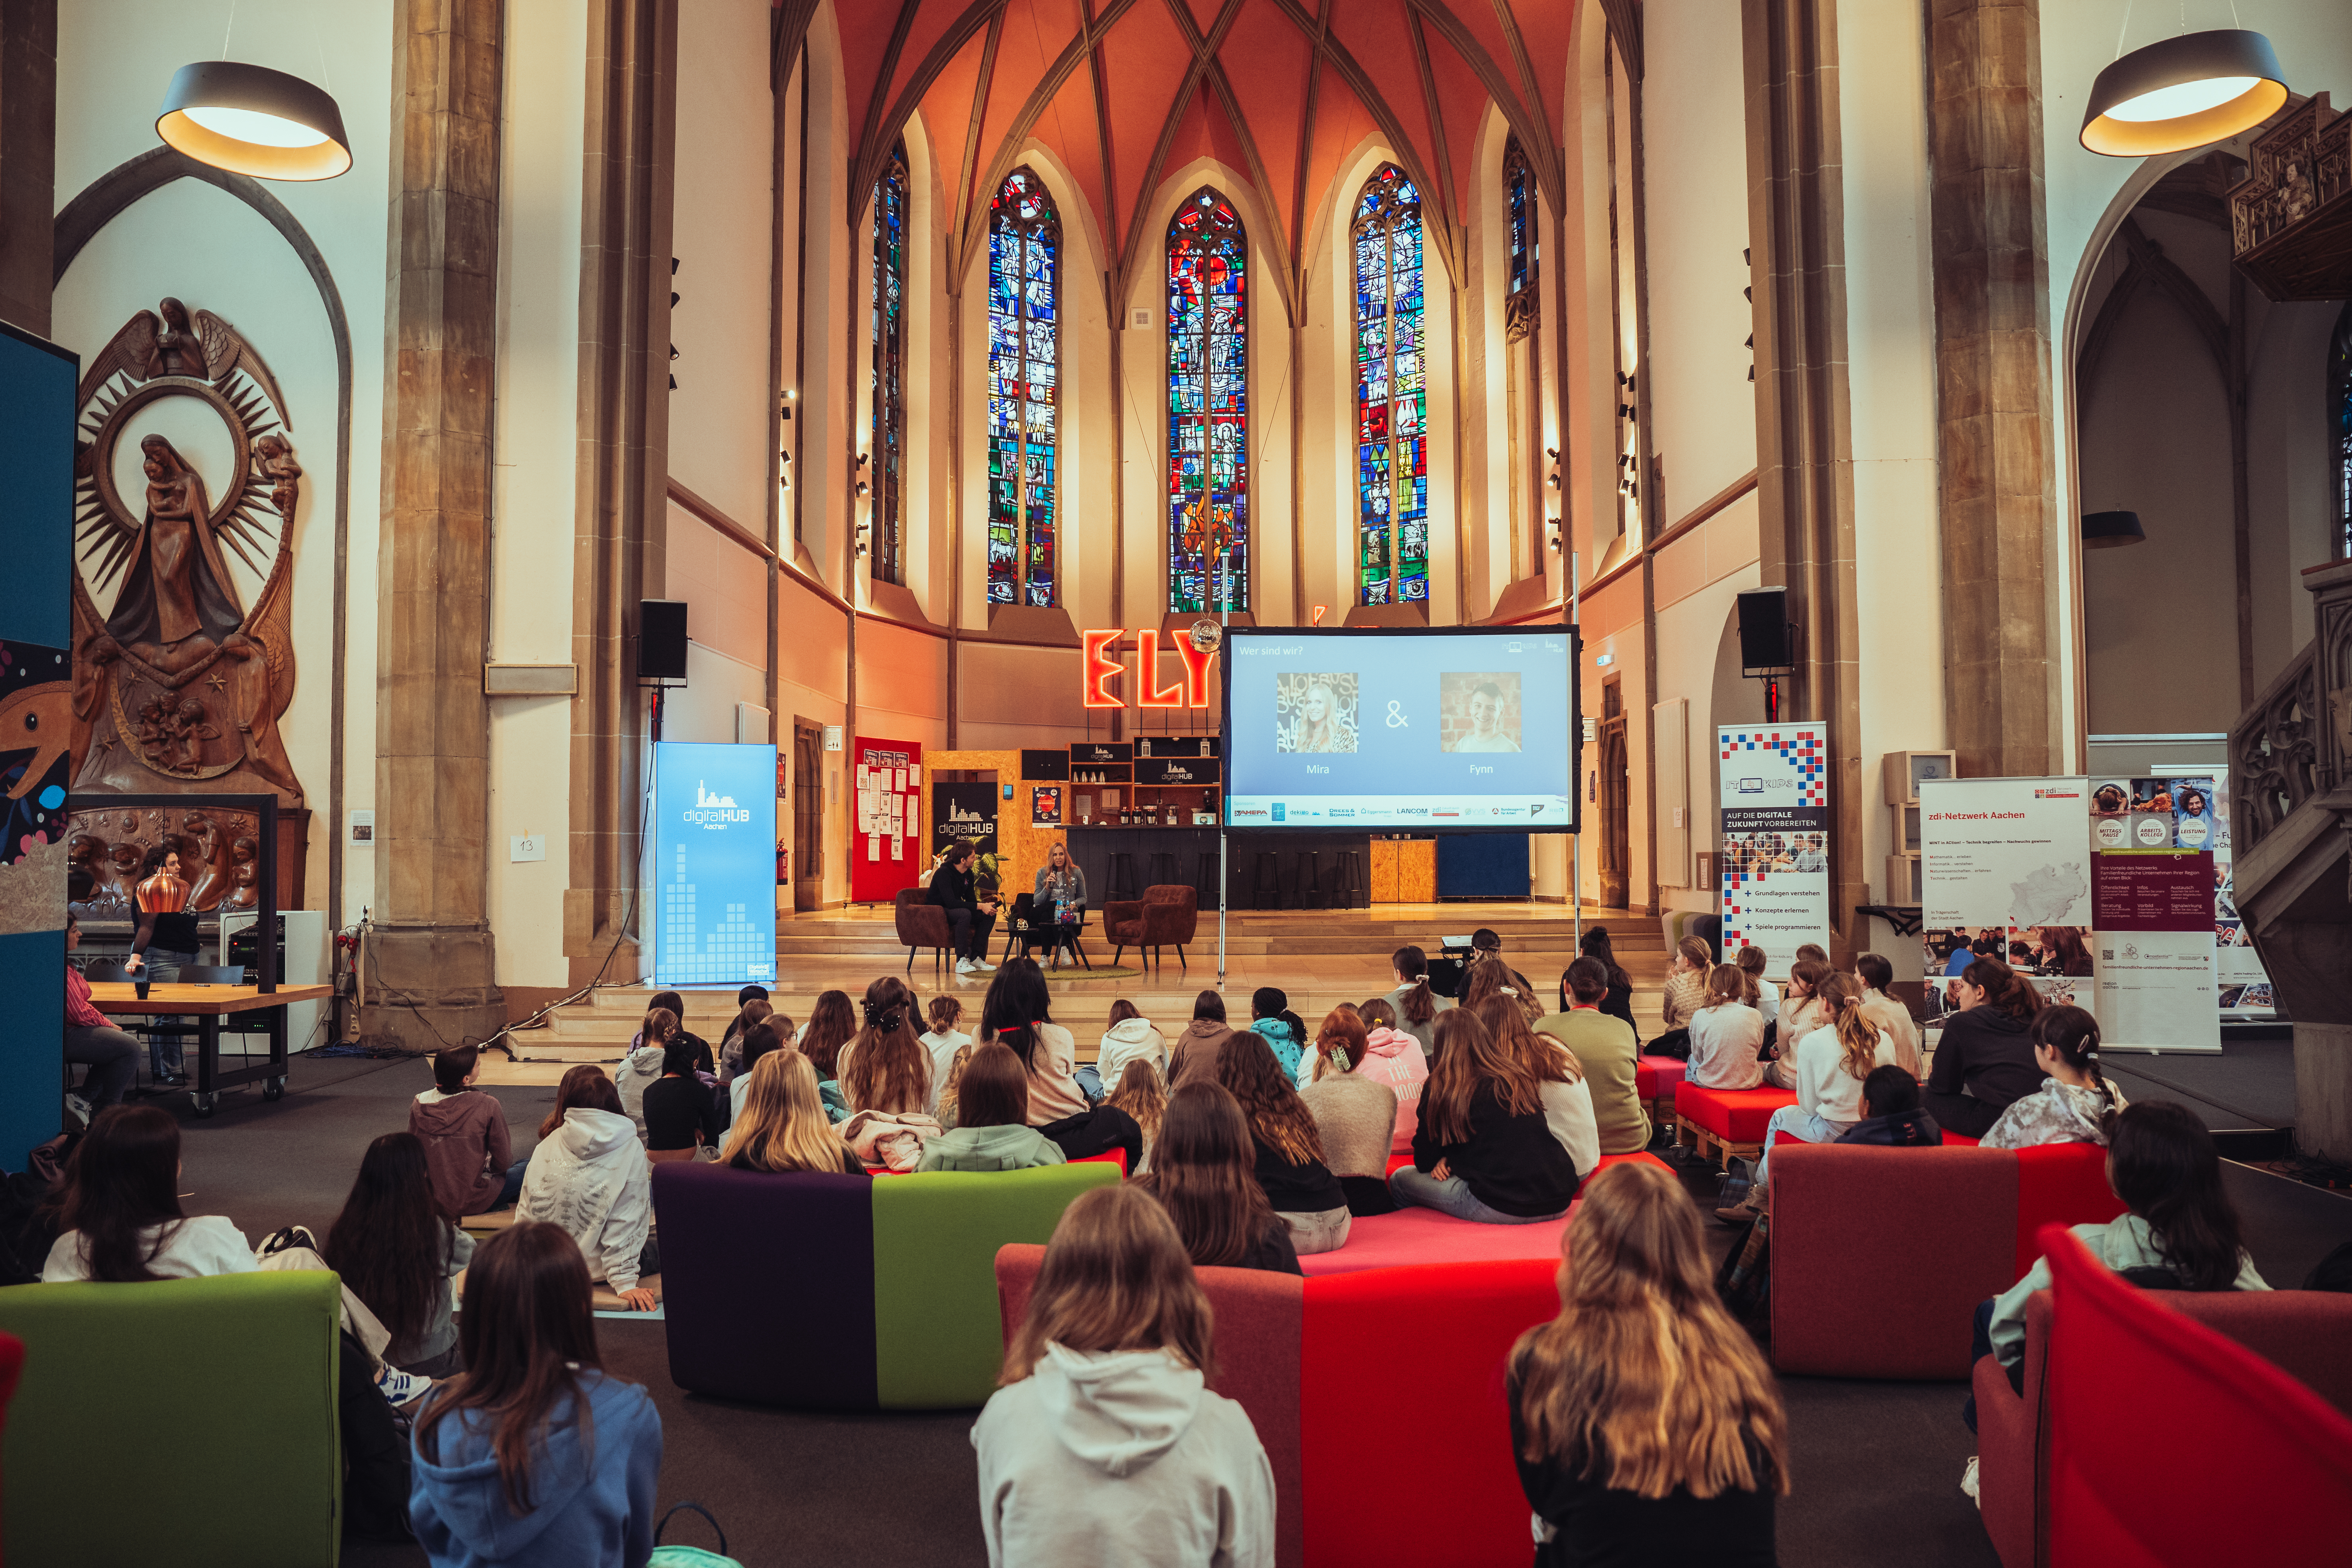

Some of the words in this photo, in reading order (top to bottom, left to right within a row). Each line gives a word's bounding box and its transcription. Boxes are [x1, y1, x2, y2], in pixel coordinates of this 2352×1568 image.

[1261, 646, 1280, 655] sind
[1283, 646, 1303, 655] wir?
[1386, 700, 1408, 728] &
[1307, 765, 1329, 774] Mira
[1470, 765, 1493, 775] Fynn
[1726, 781, 1739, 789] IT
[1747, 779, 1754, 789] 4
[1763, 779, 1793, 789] KIDS
[683, 809, 749, 824] digitalHUB
[939, 823, 993, 835] digitalHUB
[520, 840, 533, 851] 13
[1385, 1065, 1415, 1082] THE
